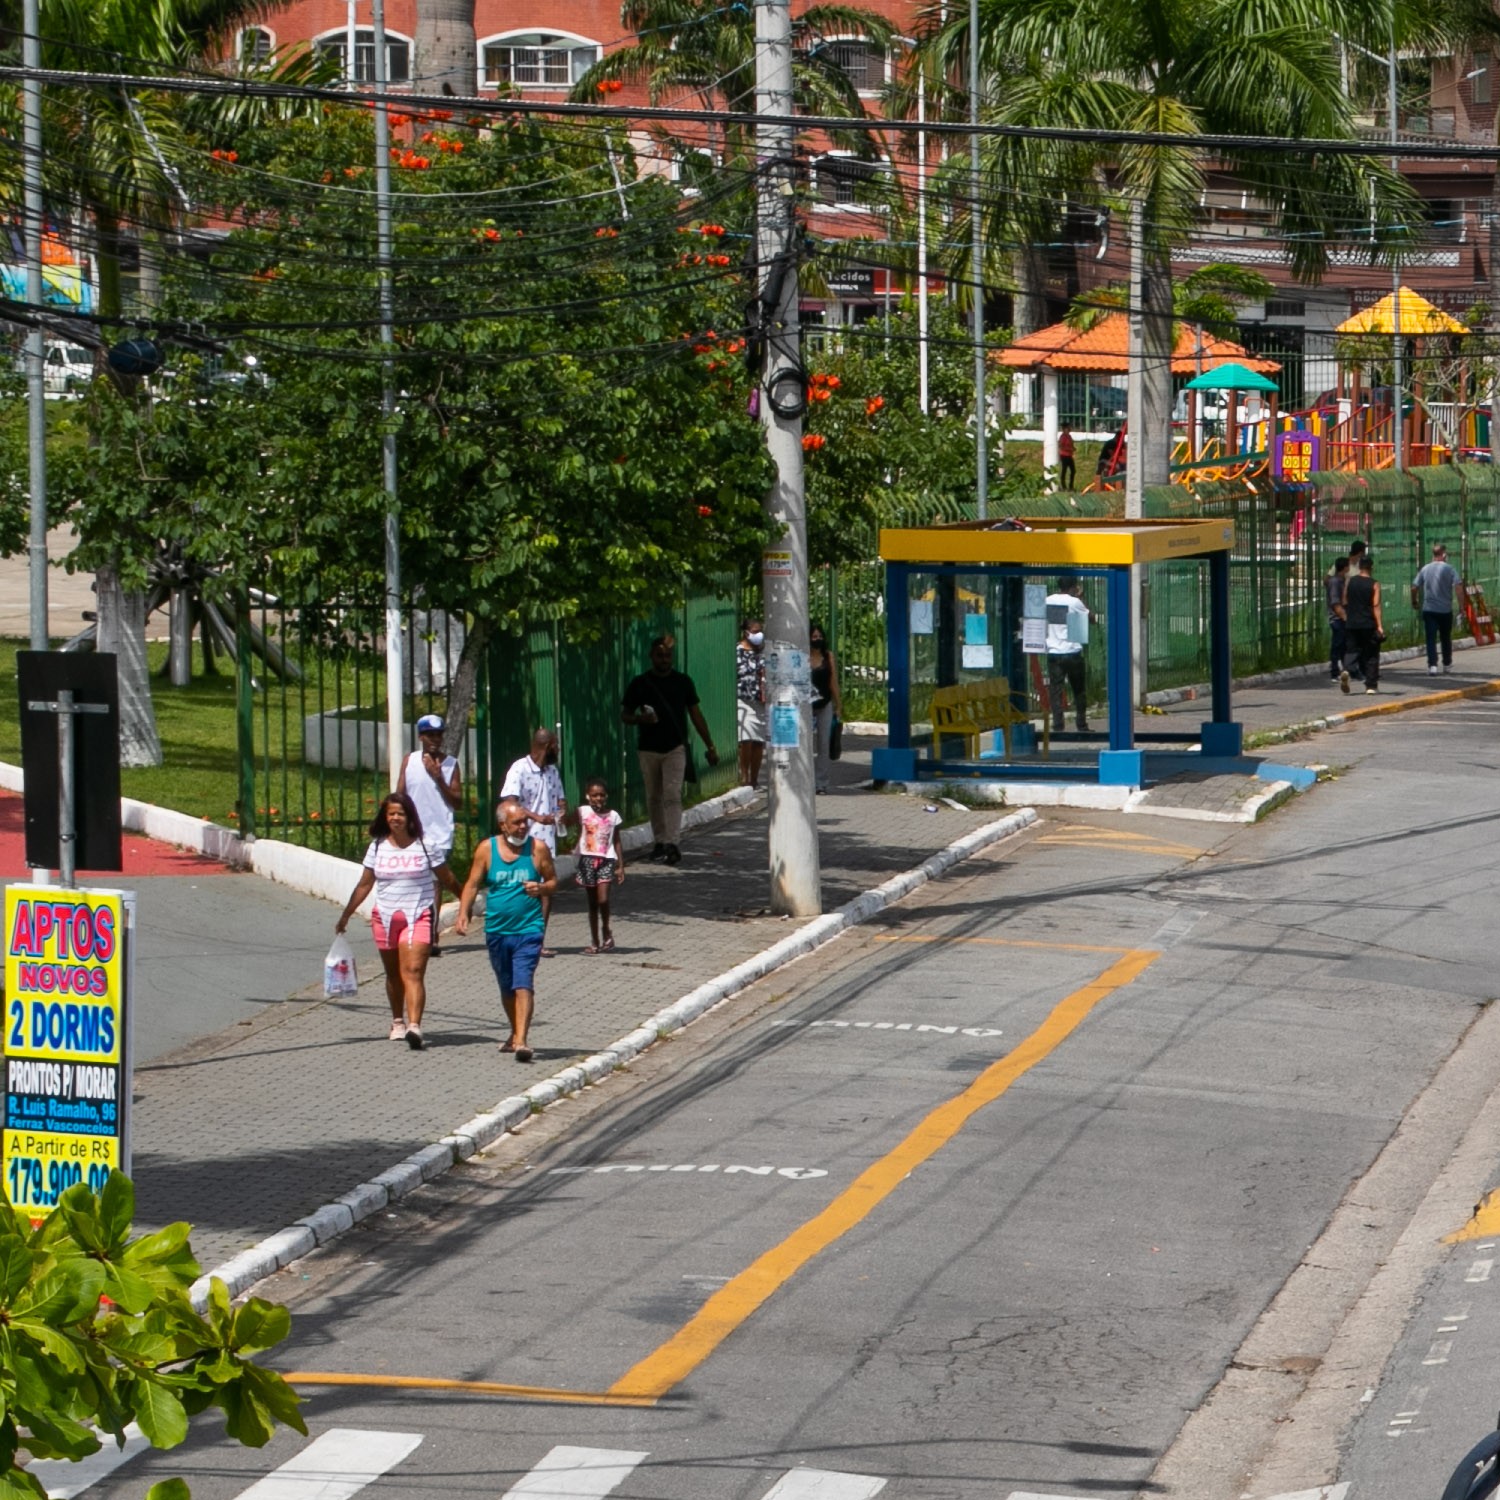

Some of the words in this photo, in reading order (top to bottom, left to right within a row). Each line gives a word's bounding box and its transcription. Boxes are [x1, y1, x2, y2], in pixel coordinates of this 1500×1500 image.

[377, 855, 424, 869] LOVE
[495, 870, 529, 885] RUN
[10, 899, 116, 963] APTOS
[19, 961, 108, 996] NOVOS
[11, 999, 24, 1047] 2
[32, 1001, 115, 1053] DORMS
[8, 1060, 61, 1096] PRONTOS
[62, 1064, 74, 1100] P/
[76, 1065, 116, 1100] MORAR
[8, 1095, 20, 1114] R.
[50, 1099, 100, 1123] Ramalho,
[102, 1103, 116, 1121] 96
[8, 1115, 44, 1130] Ferraz
[46, 1118, 115, 1135] Vasconcelos
[11, 1135, 21, 1152] A
[26, 1136, 65, 1156] Partir
[70, 1139, 87, 1157] de
[92, 1140, 110, 1159] R$
